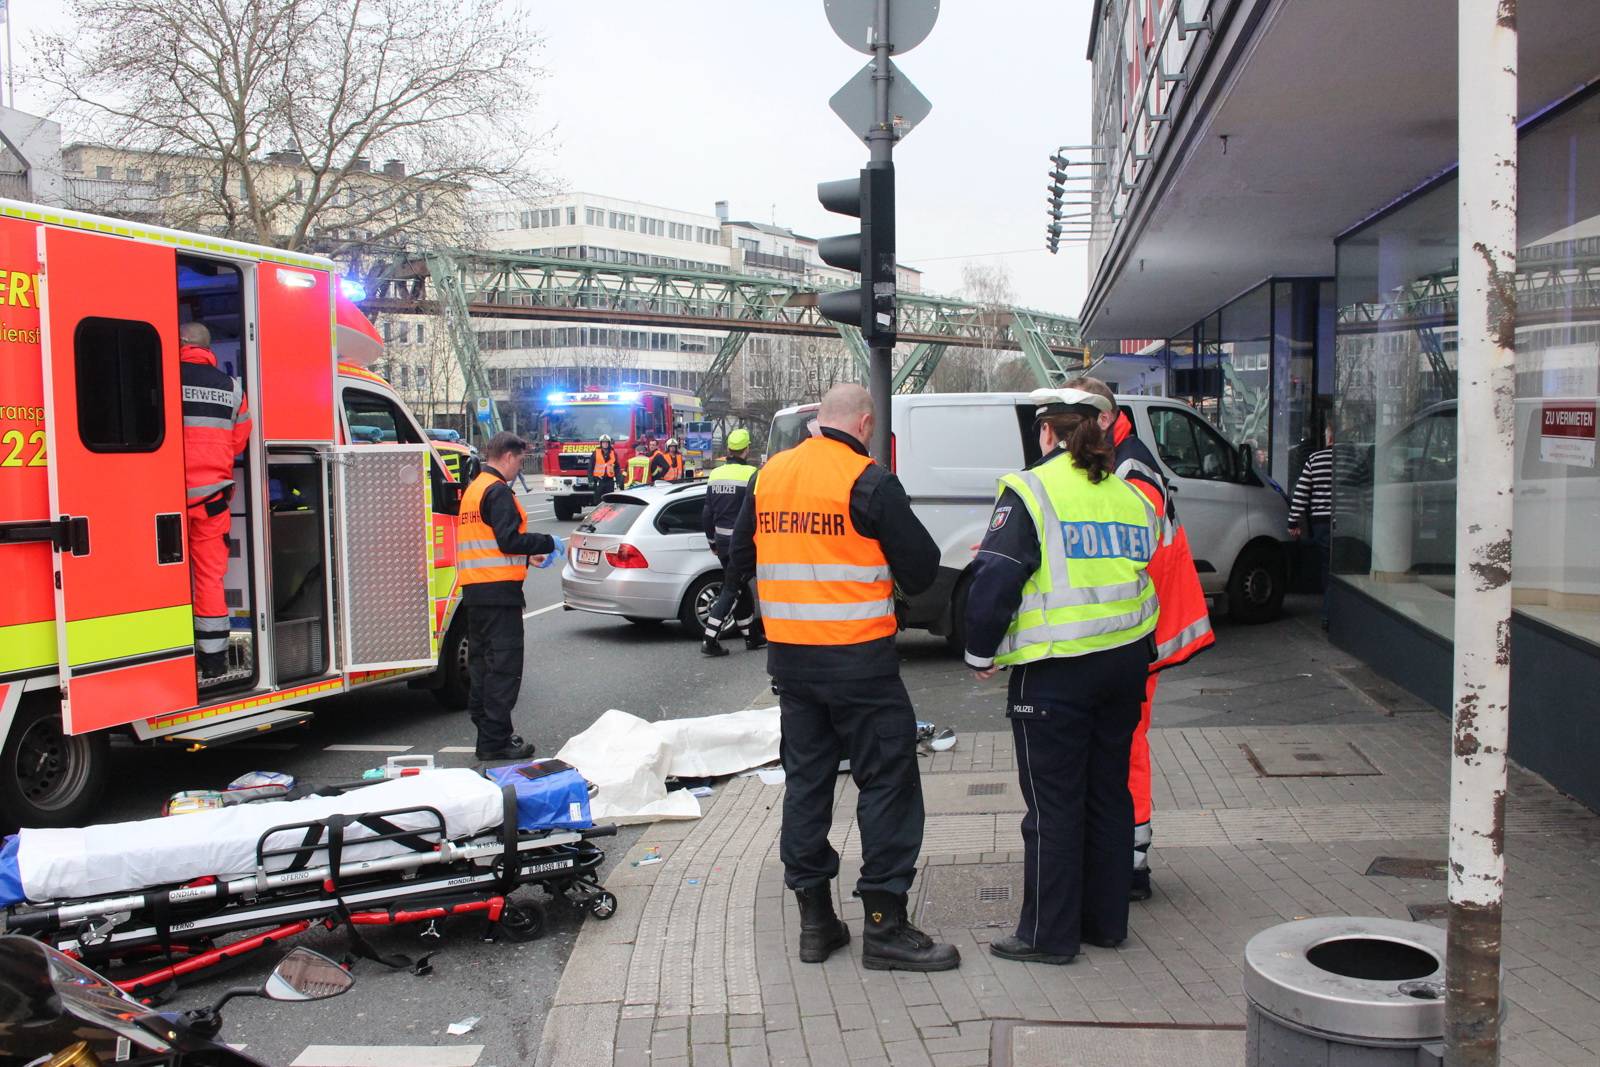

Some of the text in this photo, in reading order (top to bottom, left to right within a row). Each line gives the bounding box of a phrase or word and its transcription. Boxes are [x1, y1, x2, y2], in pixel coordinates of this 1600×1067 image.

[0, 322, 40, 344] ienst
[1545, 411, 1593, 426] ZU VERMIETEN
[0, 429, 48, 467] 22
[711, 485, 736, 495] POLIZEI
[758, 511, 845, 536] FEUERWEHR
[1063, 524, 1149, 559] POLIZEI
[1013, 704, 1034, 712] POLIZEI
[286, 872, 309, 882] FERNO
[448, 875, 475, 886] MONDIAL
[171, 921, 195, 932] FERNO
